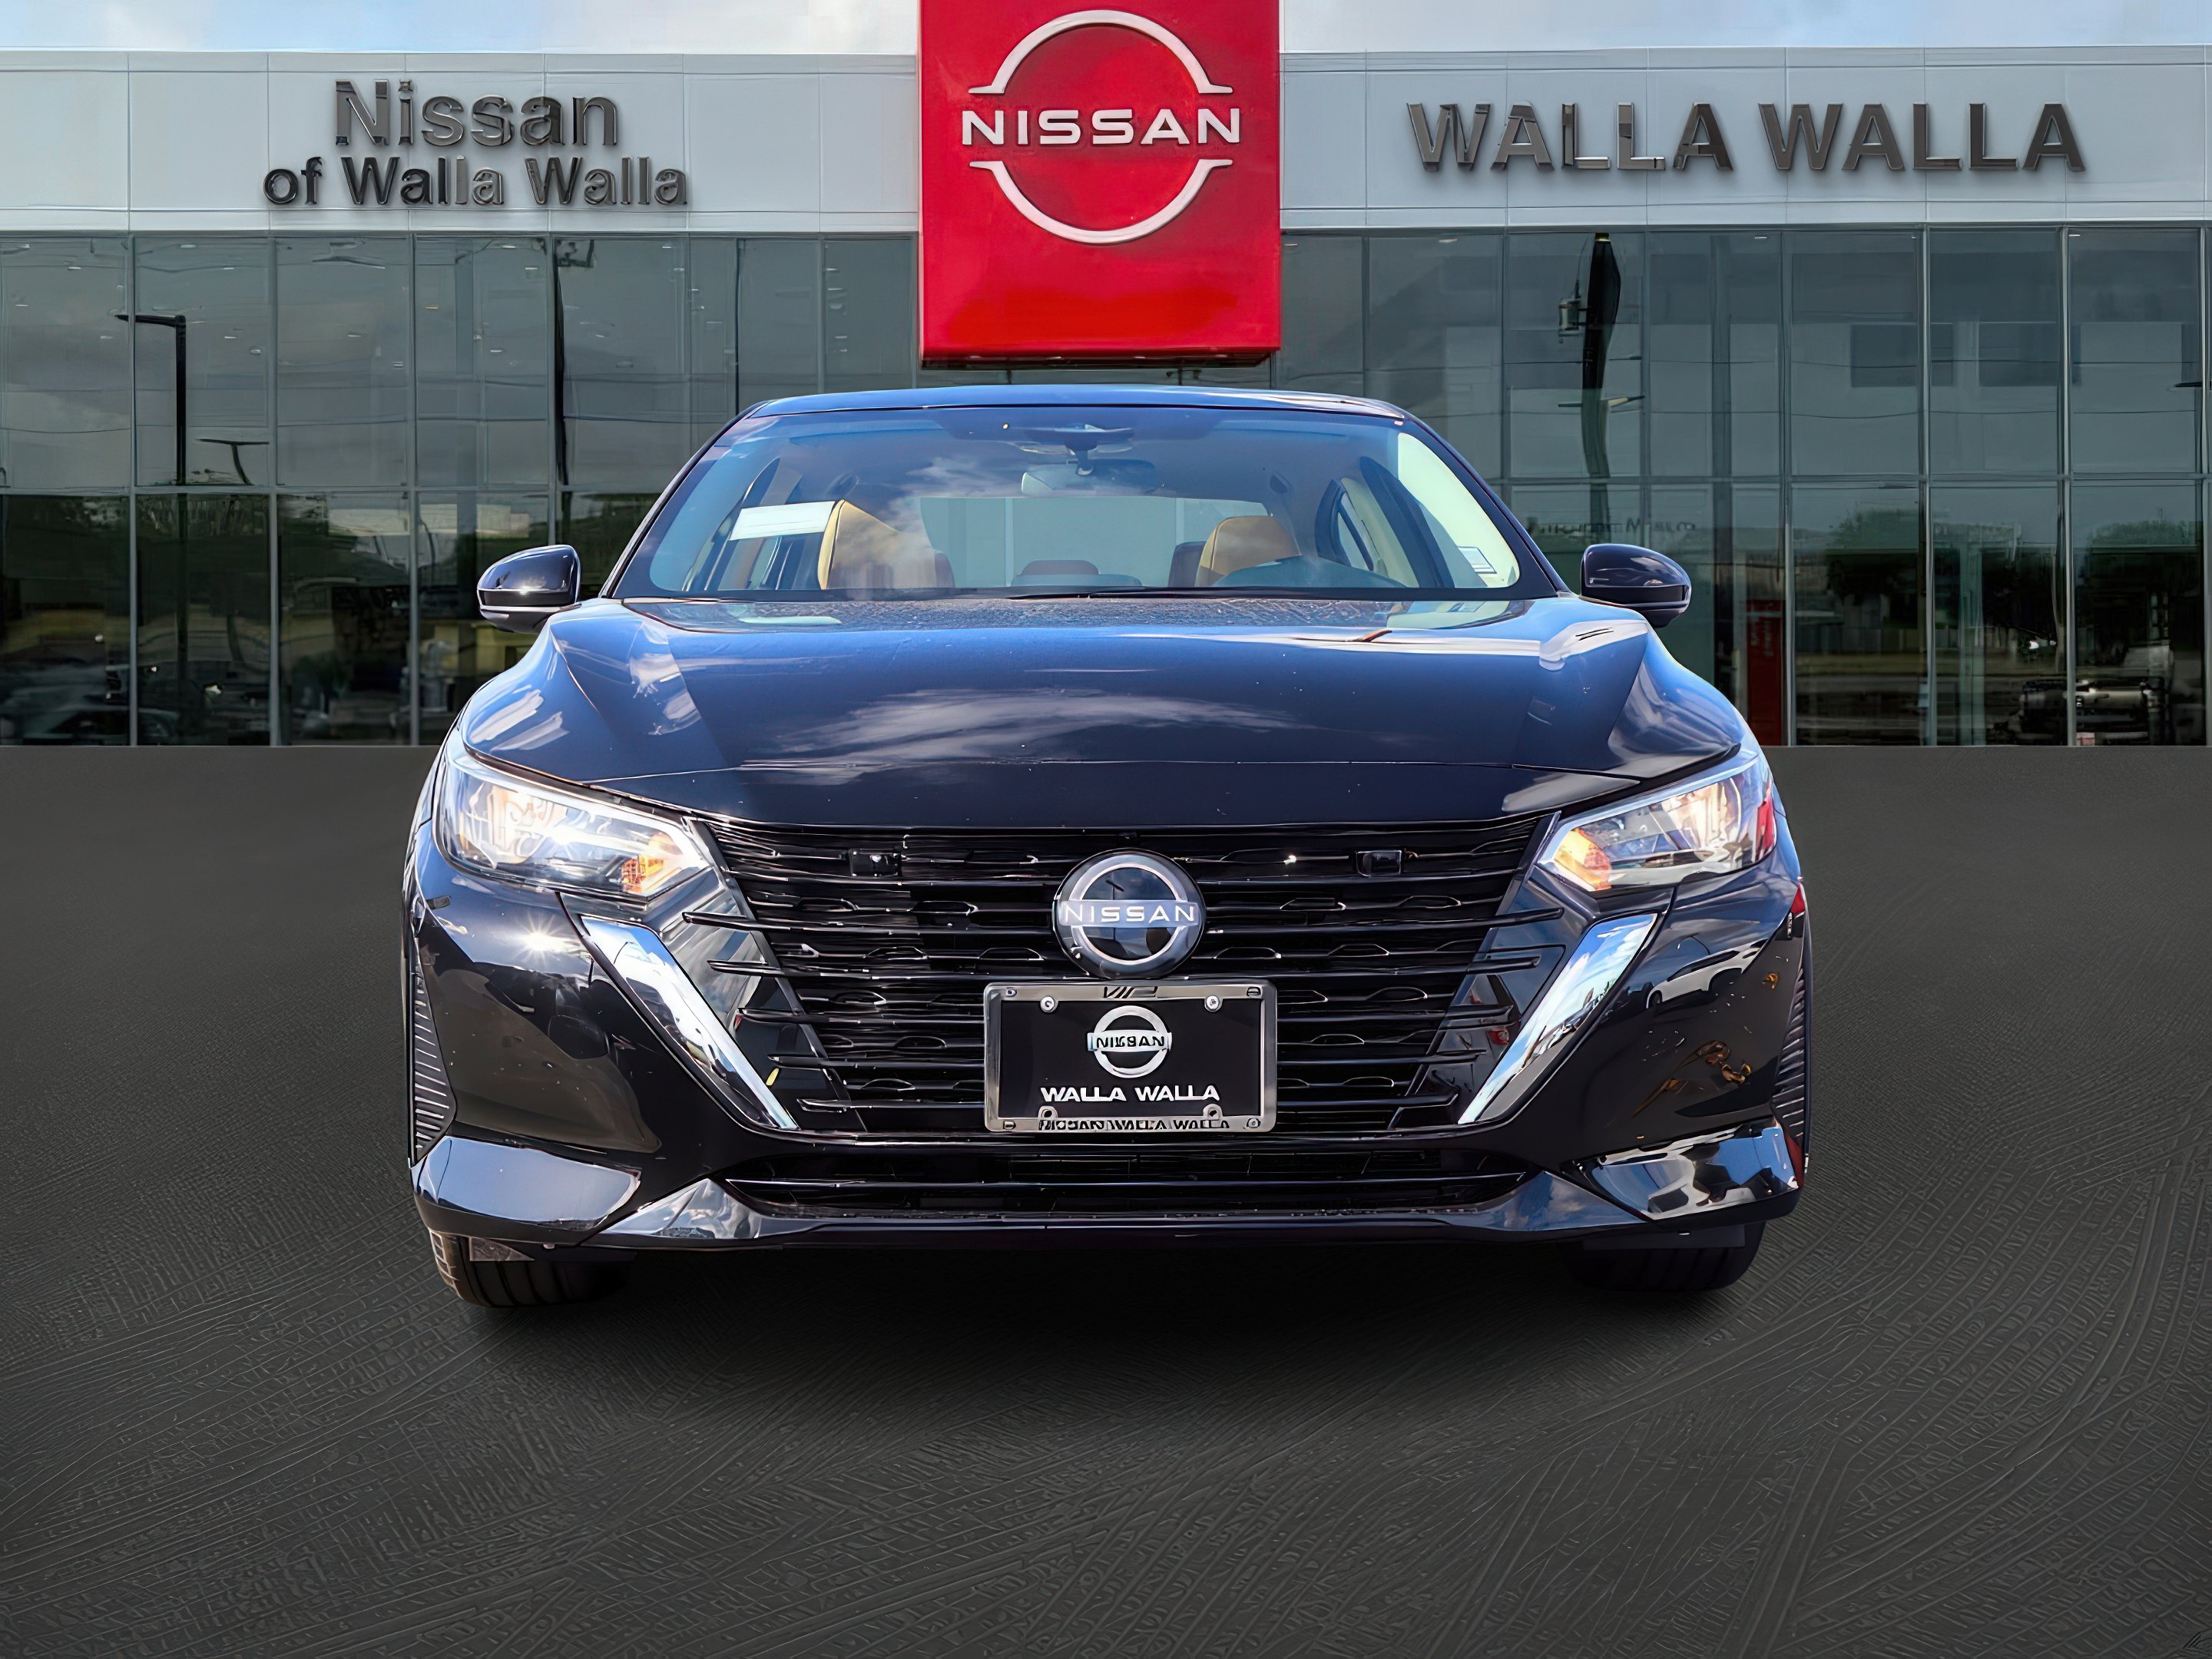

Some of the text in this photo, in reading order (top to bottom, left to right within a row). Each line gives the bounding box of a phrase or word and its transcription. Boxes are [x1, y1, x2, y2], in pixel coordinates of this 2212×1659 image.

[335, 78, 619, 147] Nissan
[962, 108, 1241, 146] NISSAN
[1406, 101, 2086, 173] WALLA WALLA
[263, 155, 689, 207] of Walla Walla
[1065, 905, 1194, 923] NISSAN
[1040, 1084, 1220, 1103] WALLA WALLA
